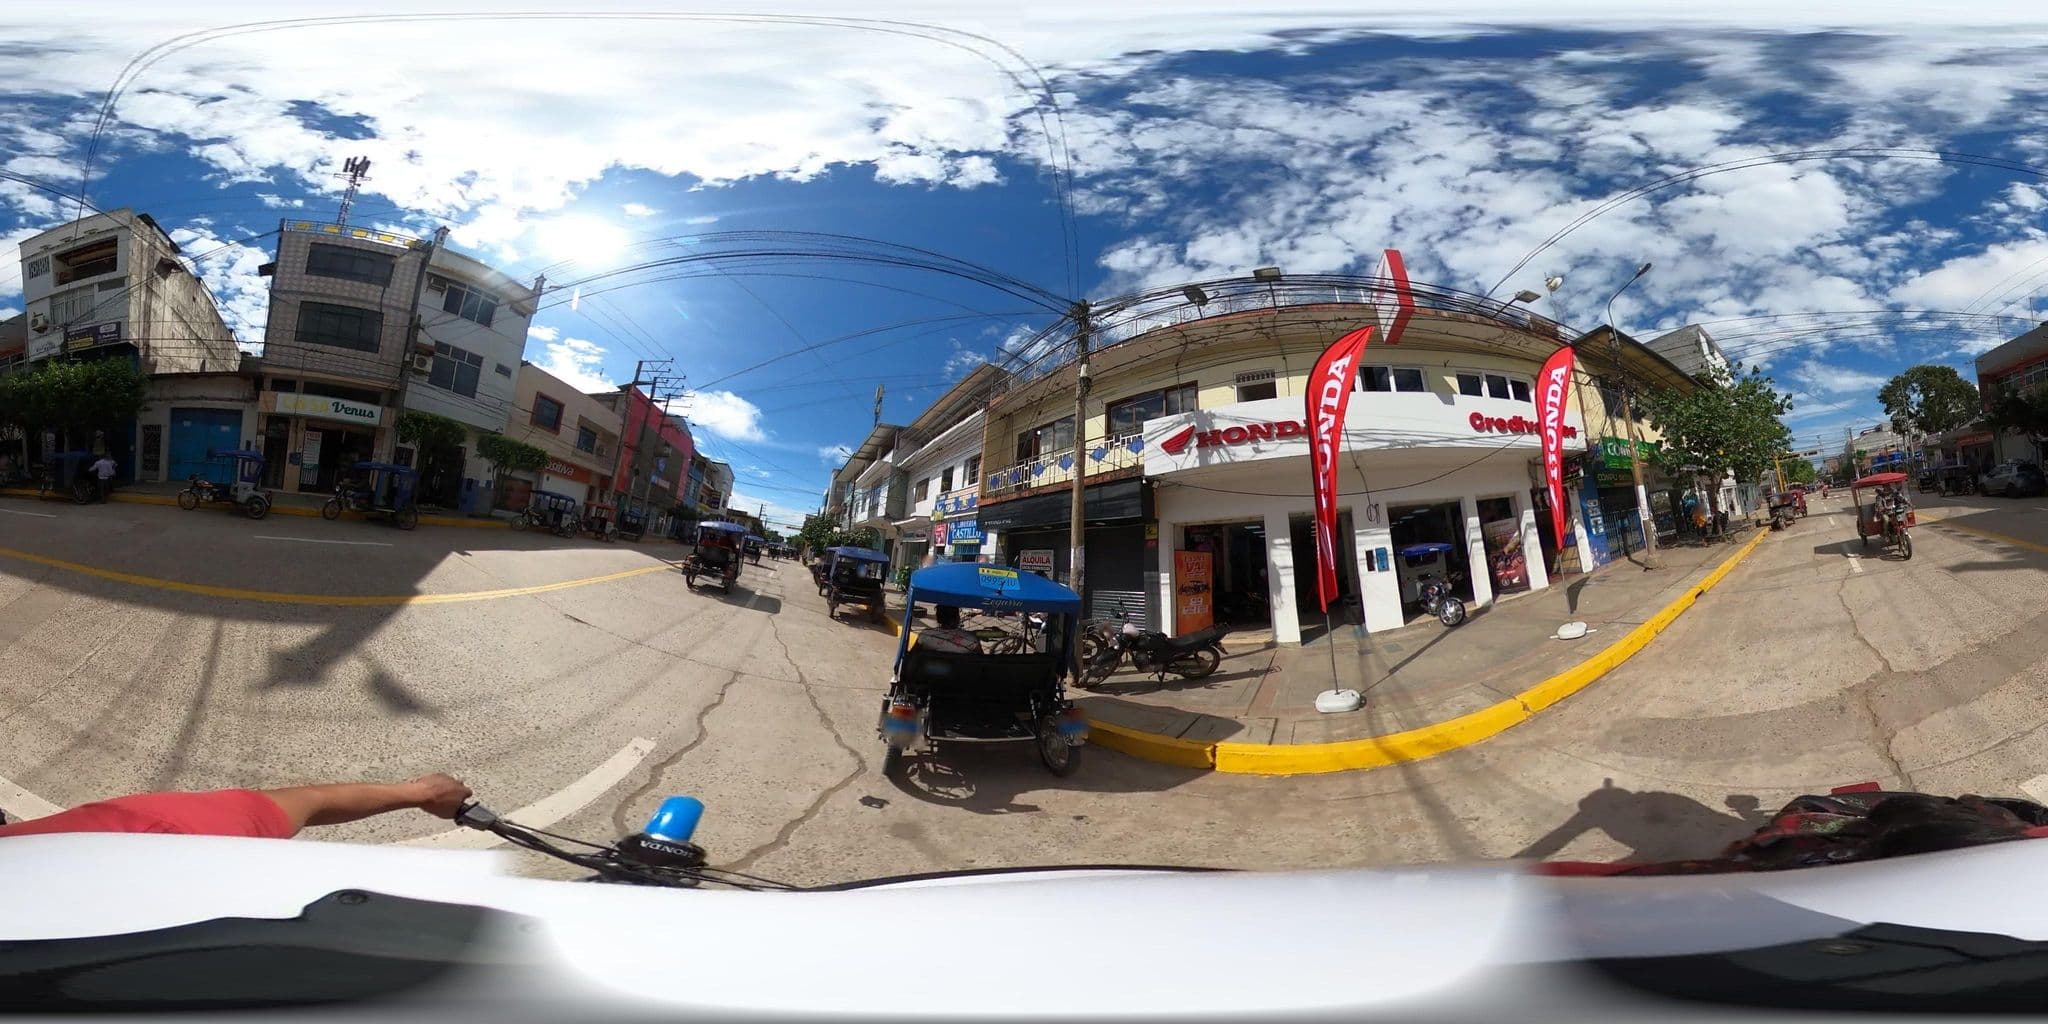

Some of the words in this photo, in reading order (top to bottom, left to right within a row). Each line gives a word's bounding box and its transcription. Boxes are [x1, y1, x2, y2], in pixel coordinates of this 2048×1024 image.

[332, 401, 375, 419] Venus
[1195, 420, 1309, 448] HOND
[1022, 556, 1051, 565] ALQUILA
